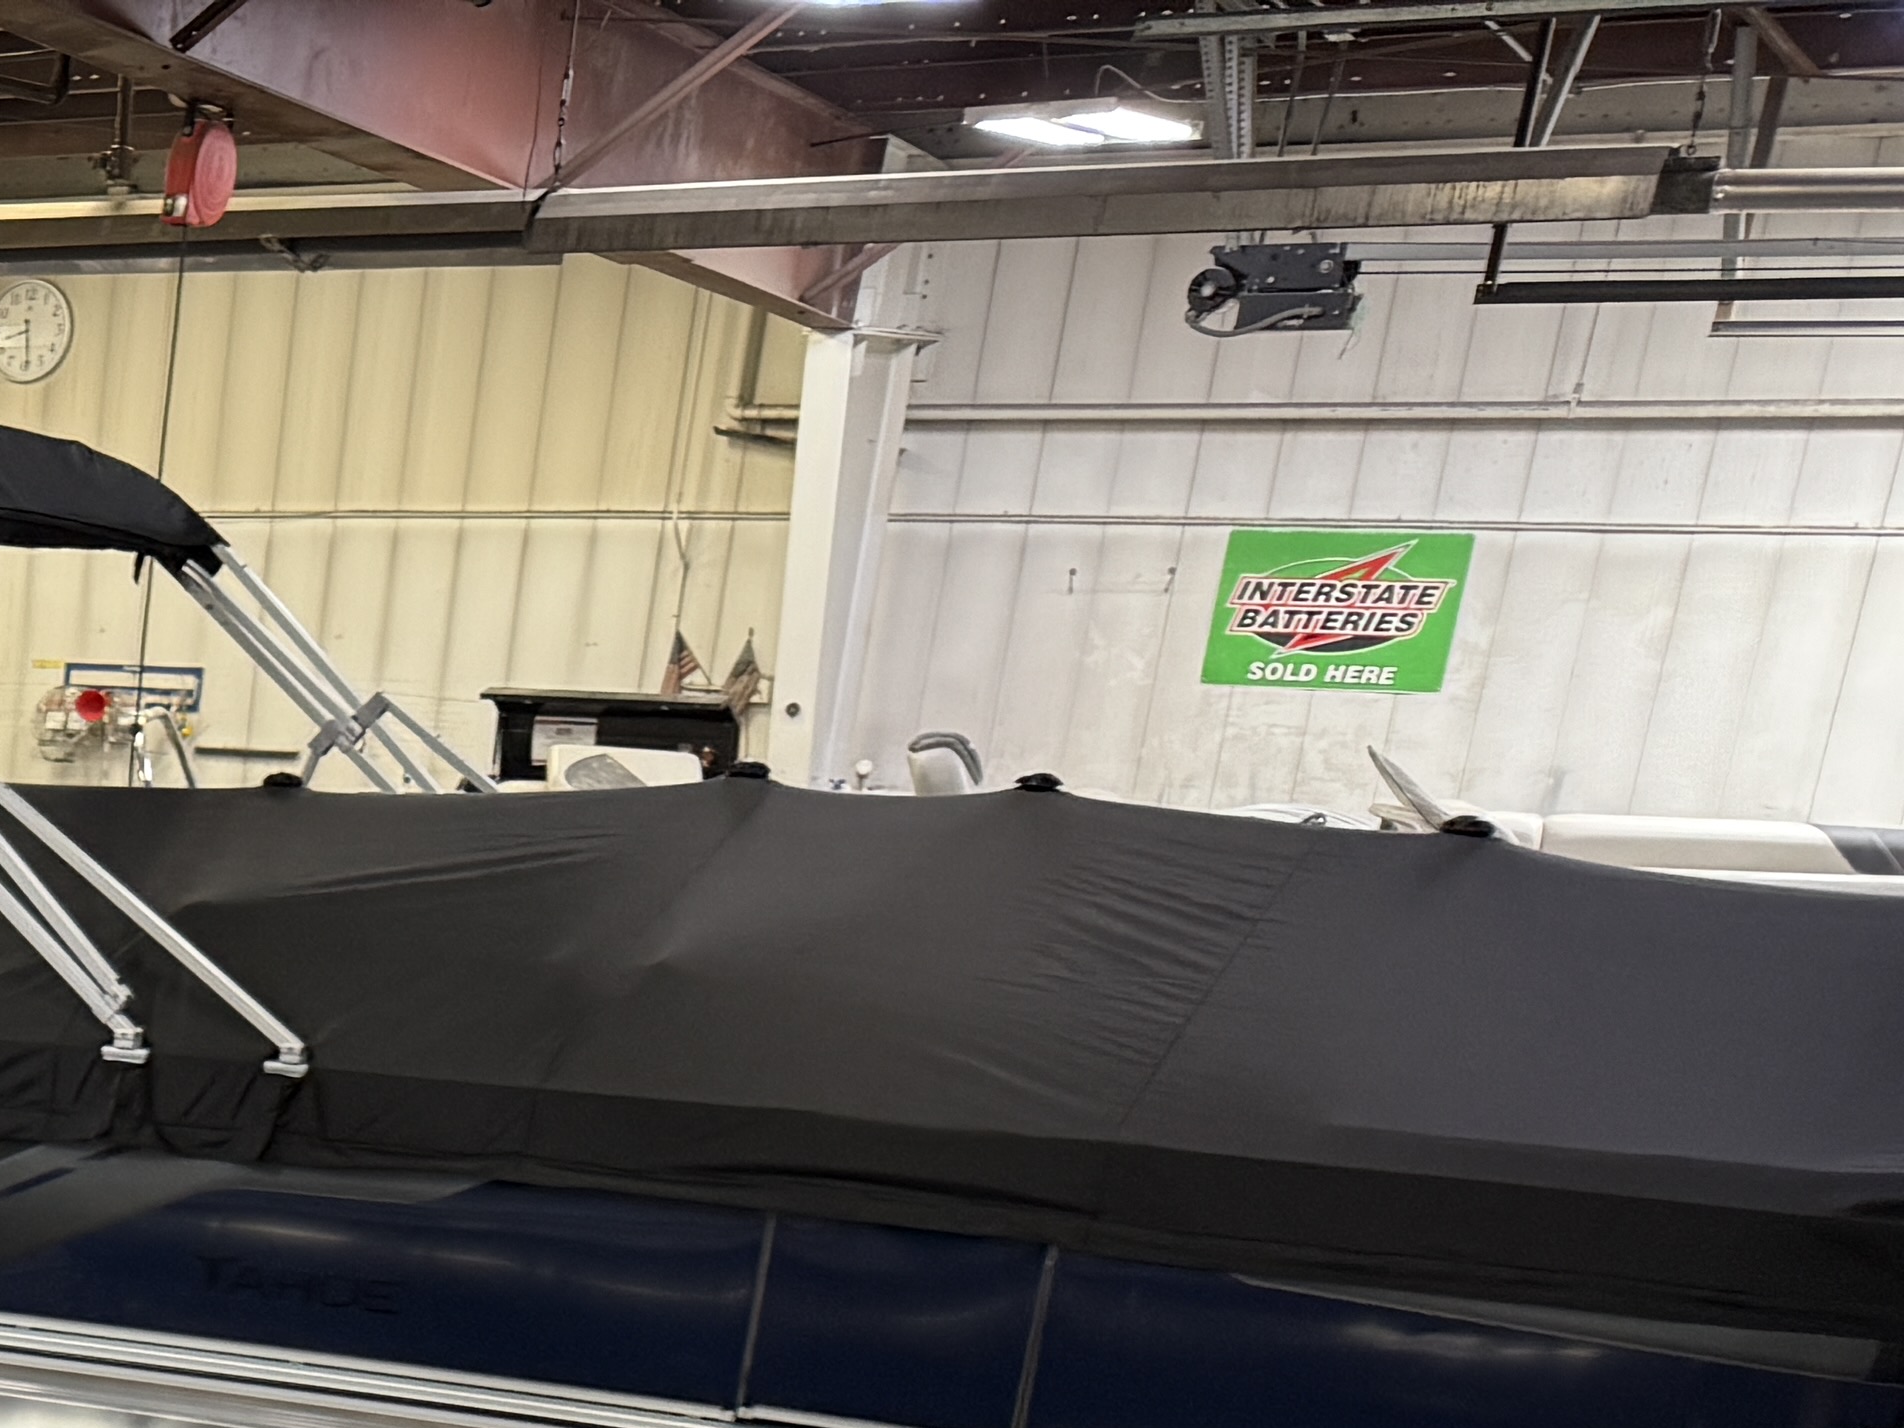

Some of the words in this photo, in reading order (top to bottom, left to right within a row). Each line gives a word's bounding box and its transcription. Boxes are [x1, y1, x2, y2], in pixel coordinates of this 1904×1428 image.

[1236, 579, 1441, 606] INTERSTATE
[1236, 608, 1420, 633] BATTERIES
[1247, 661, 1318, 683] SOLD
[1323, 664, 1399, 686] HERE
